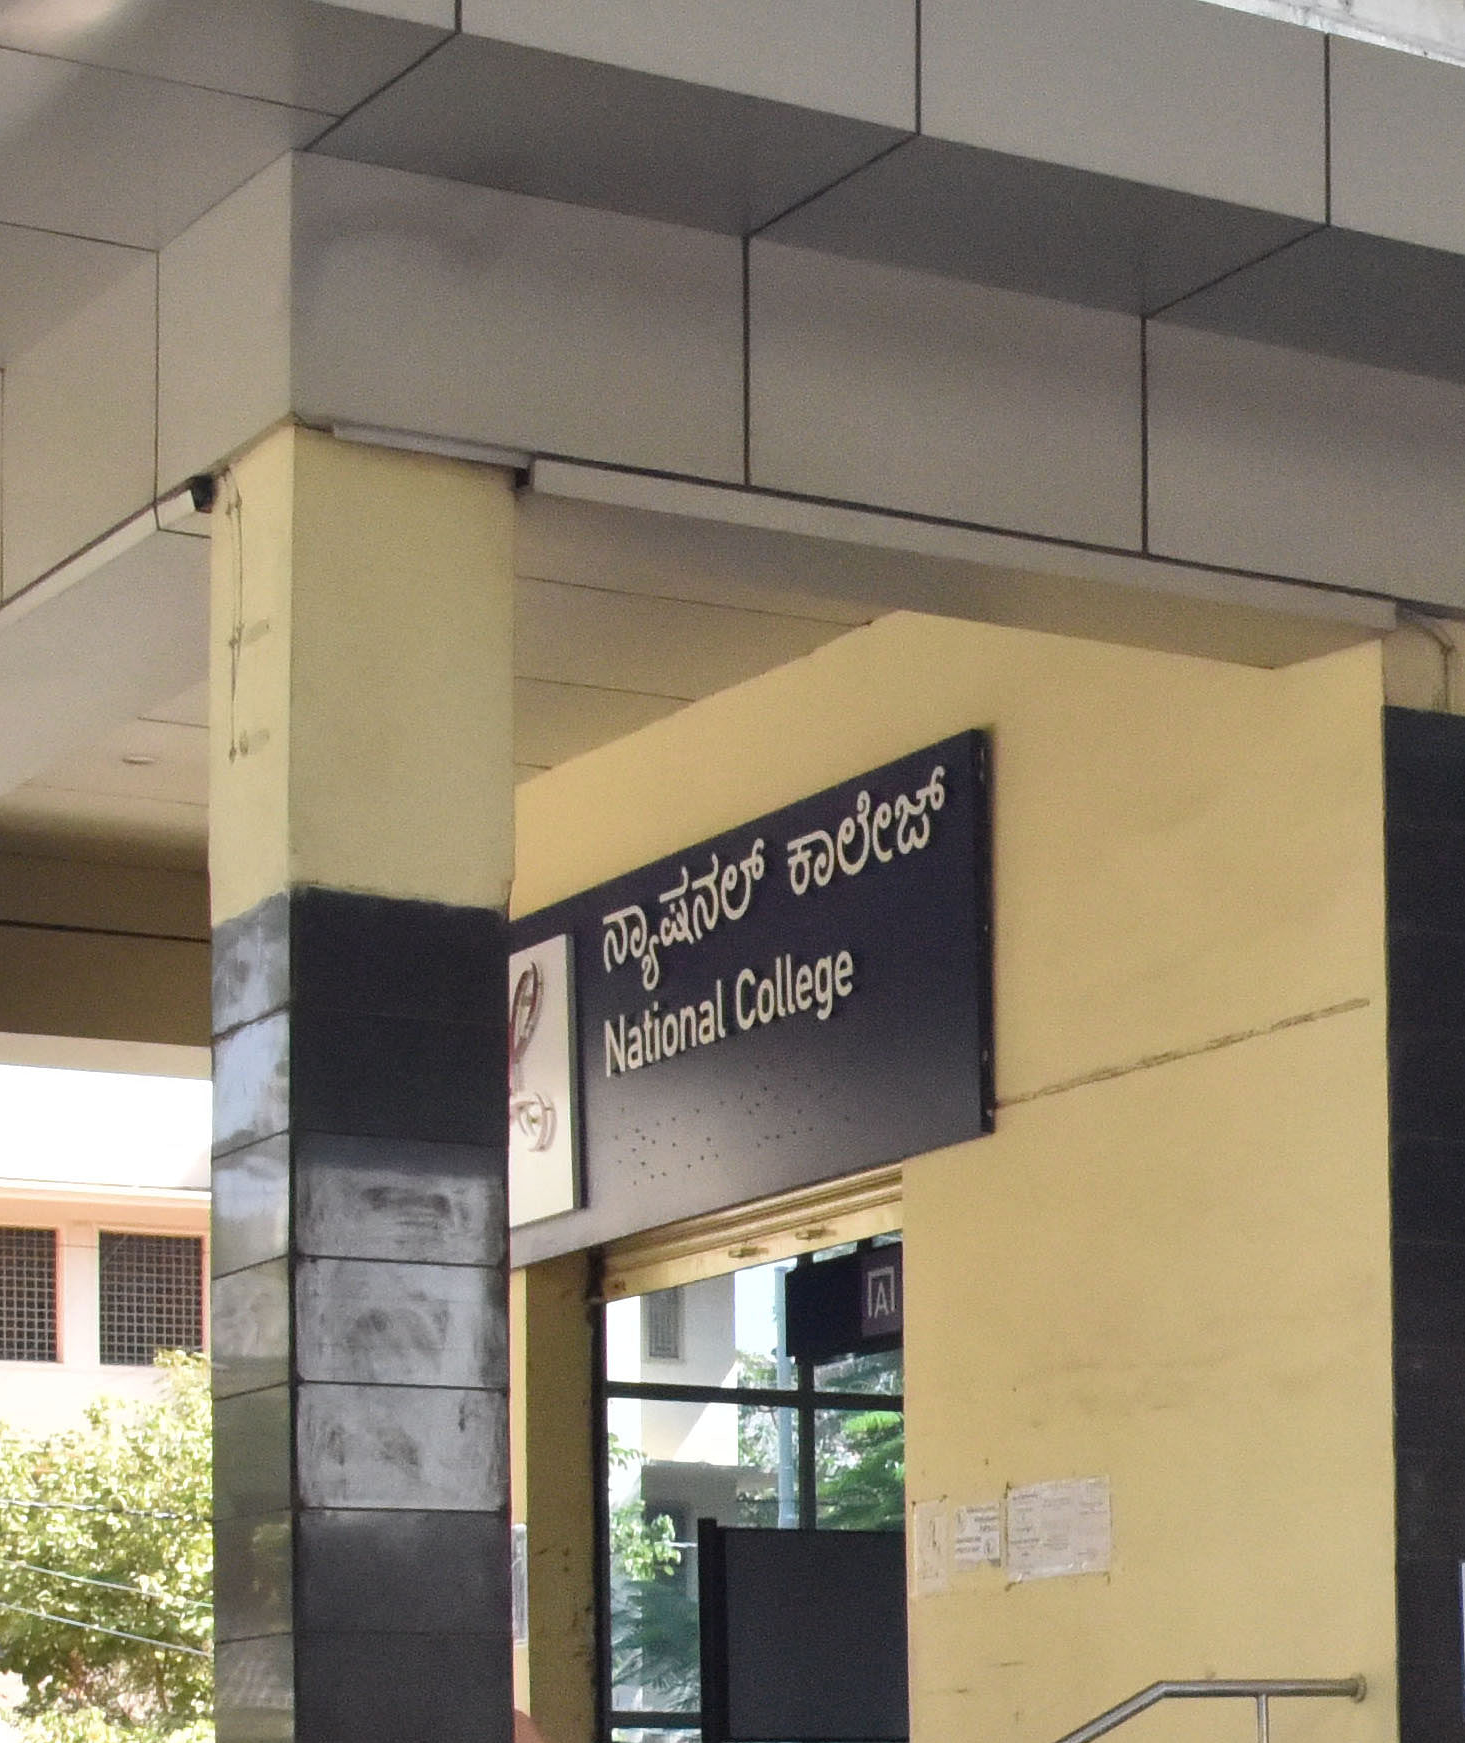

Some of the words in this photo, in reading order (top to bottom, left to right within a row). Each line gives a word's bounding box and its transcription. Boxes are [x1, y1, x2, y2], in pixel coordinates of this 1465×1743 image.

[602, 837, 765, 991] ನ್ಯಾಷನಲ್
[787, 765, 946, 896] ಕಾಲೇಜ್
[604, 979, 725, 1078] National
[735, 950, 854, 1034] College
